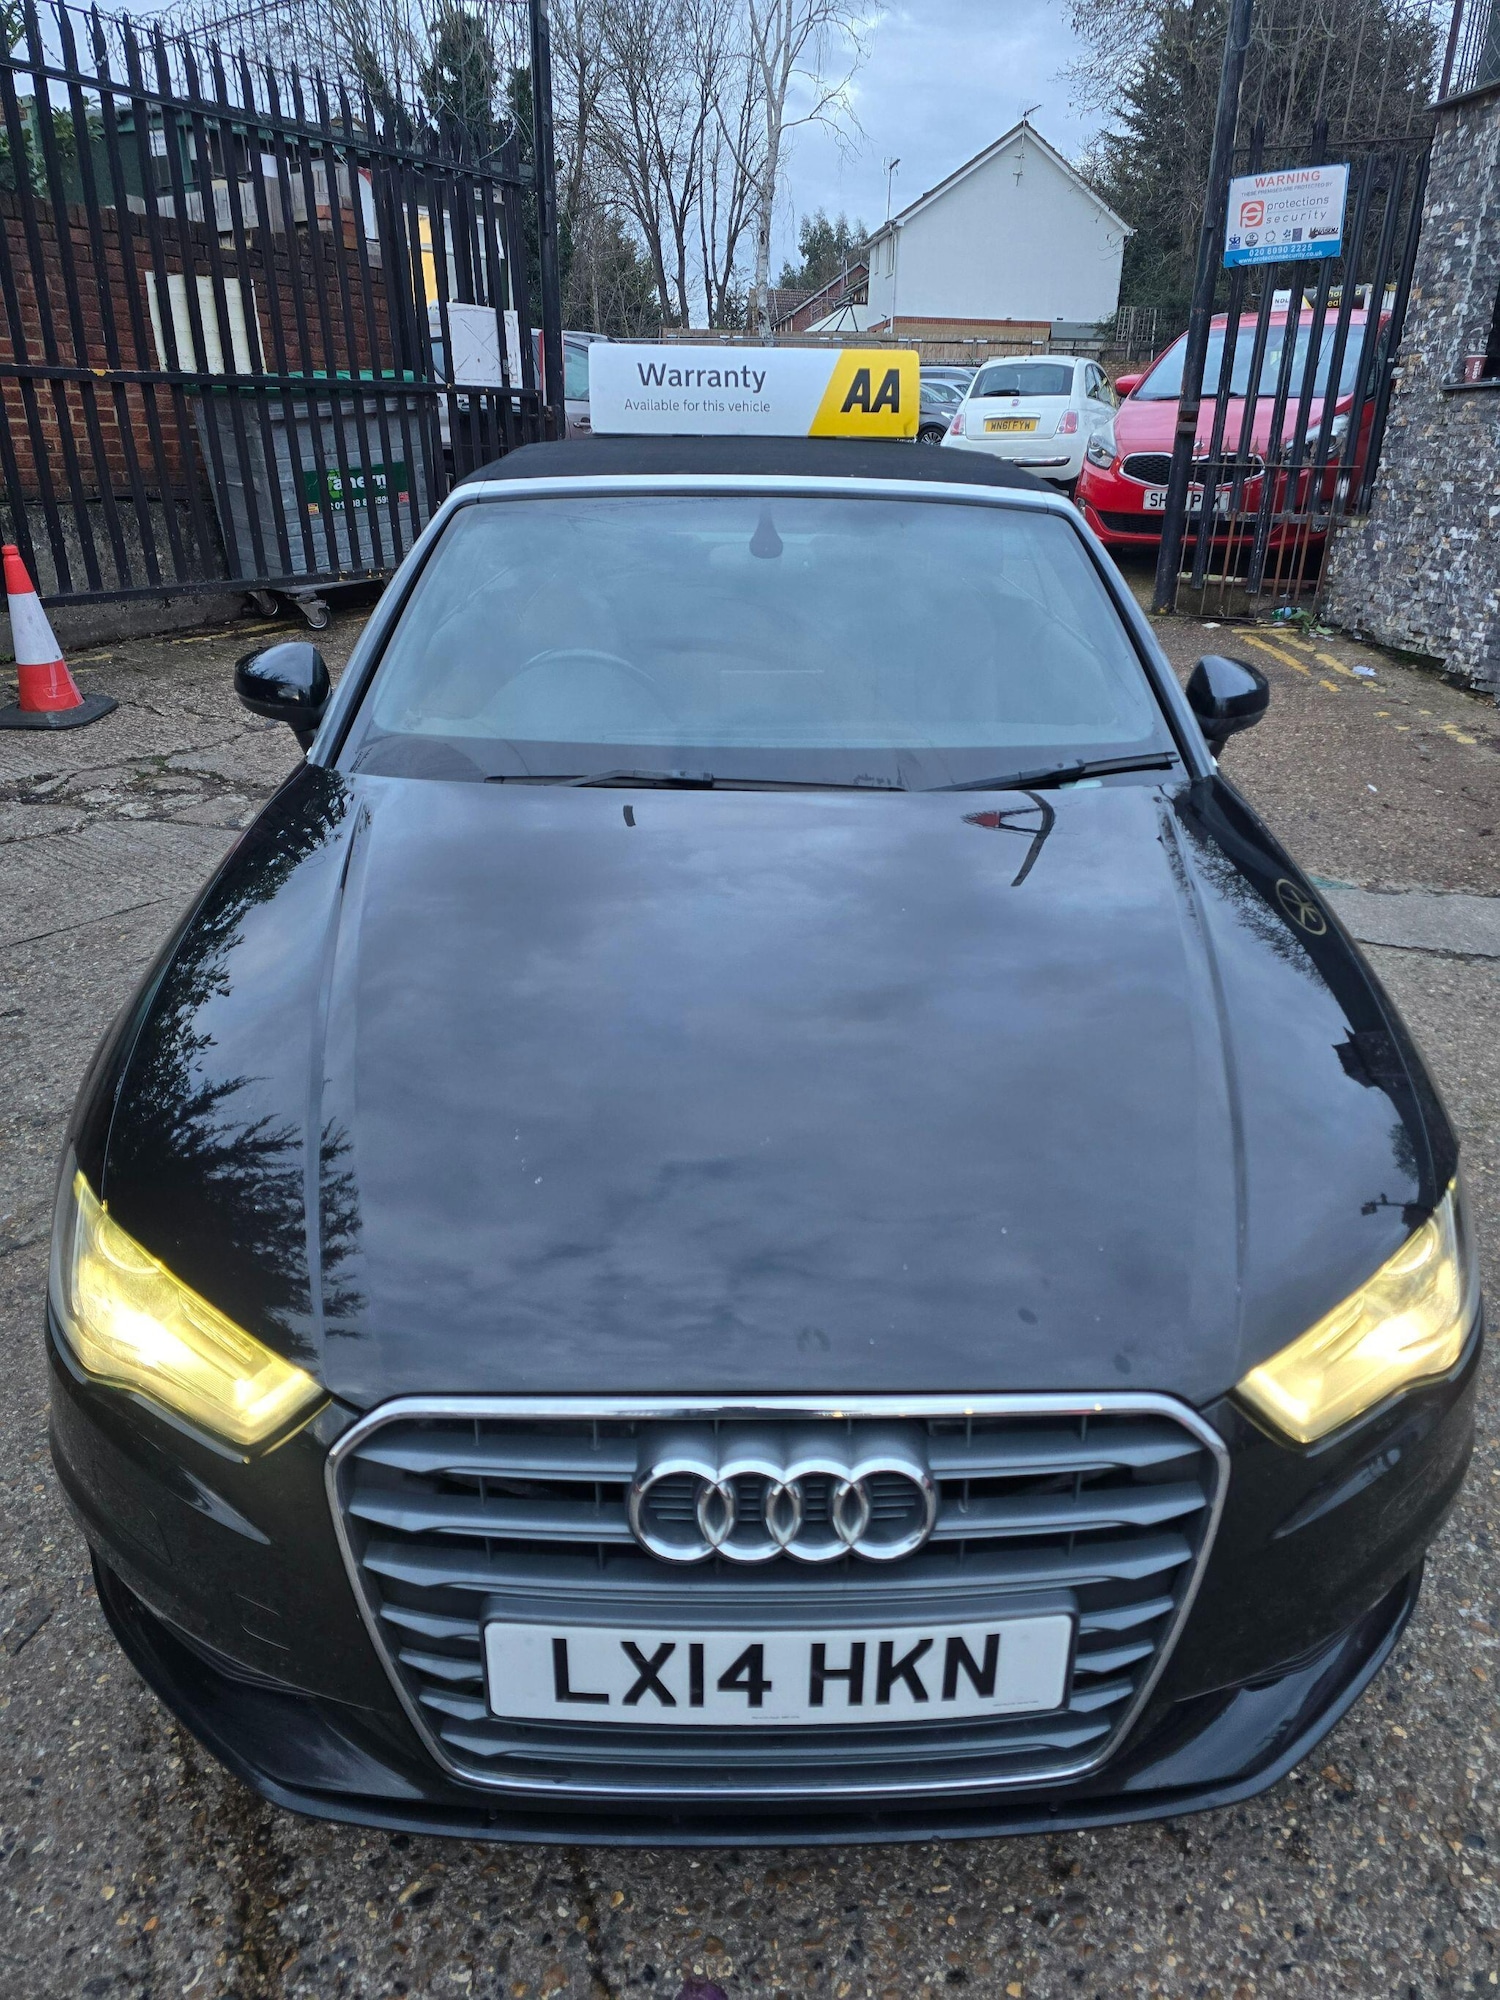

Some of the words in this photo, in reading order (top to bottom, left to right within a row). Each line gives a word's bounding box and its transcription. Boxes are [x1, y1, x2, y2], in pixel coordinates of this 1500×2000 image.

[1255, 170, 1320, 188] WARNING
[1293, 182, 1325, 191] PROTECTED
[1266, 195, 1330, 213] protections
[1266, 210, 1327, 224] security
[1248, 248, 1265, 257] 020
[1290, 243, 1313, 253] 2225
[637, 362, 767, 394] Warranty
[840, 368, 901, 414] AA
[624, 398, 679, 412] Available
[682, 398, 700, 412] for
[702, 399, 725, 413] this
[727, 400, 771, 413] vehicle
[990, 421, 1010, 431] WN61
[1011, 420, 1031, 430] FYW
[550, 1637, 773, 1708] LX14
[807, 1633, 1002, 1708] HKN
